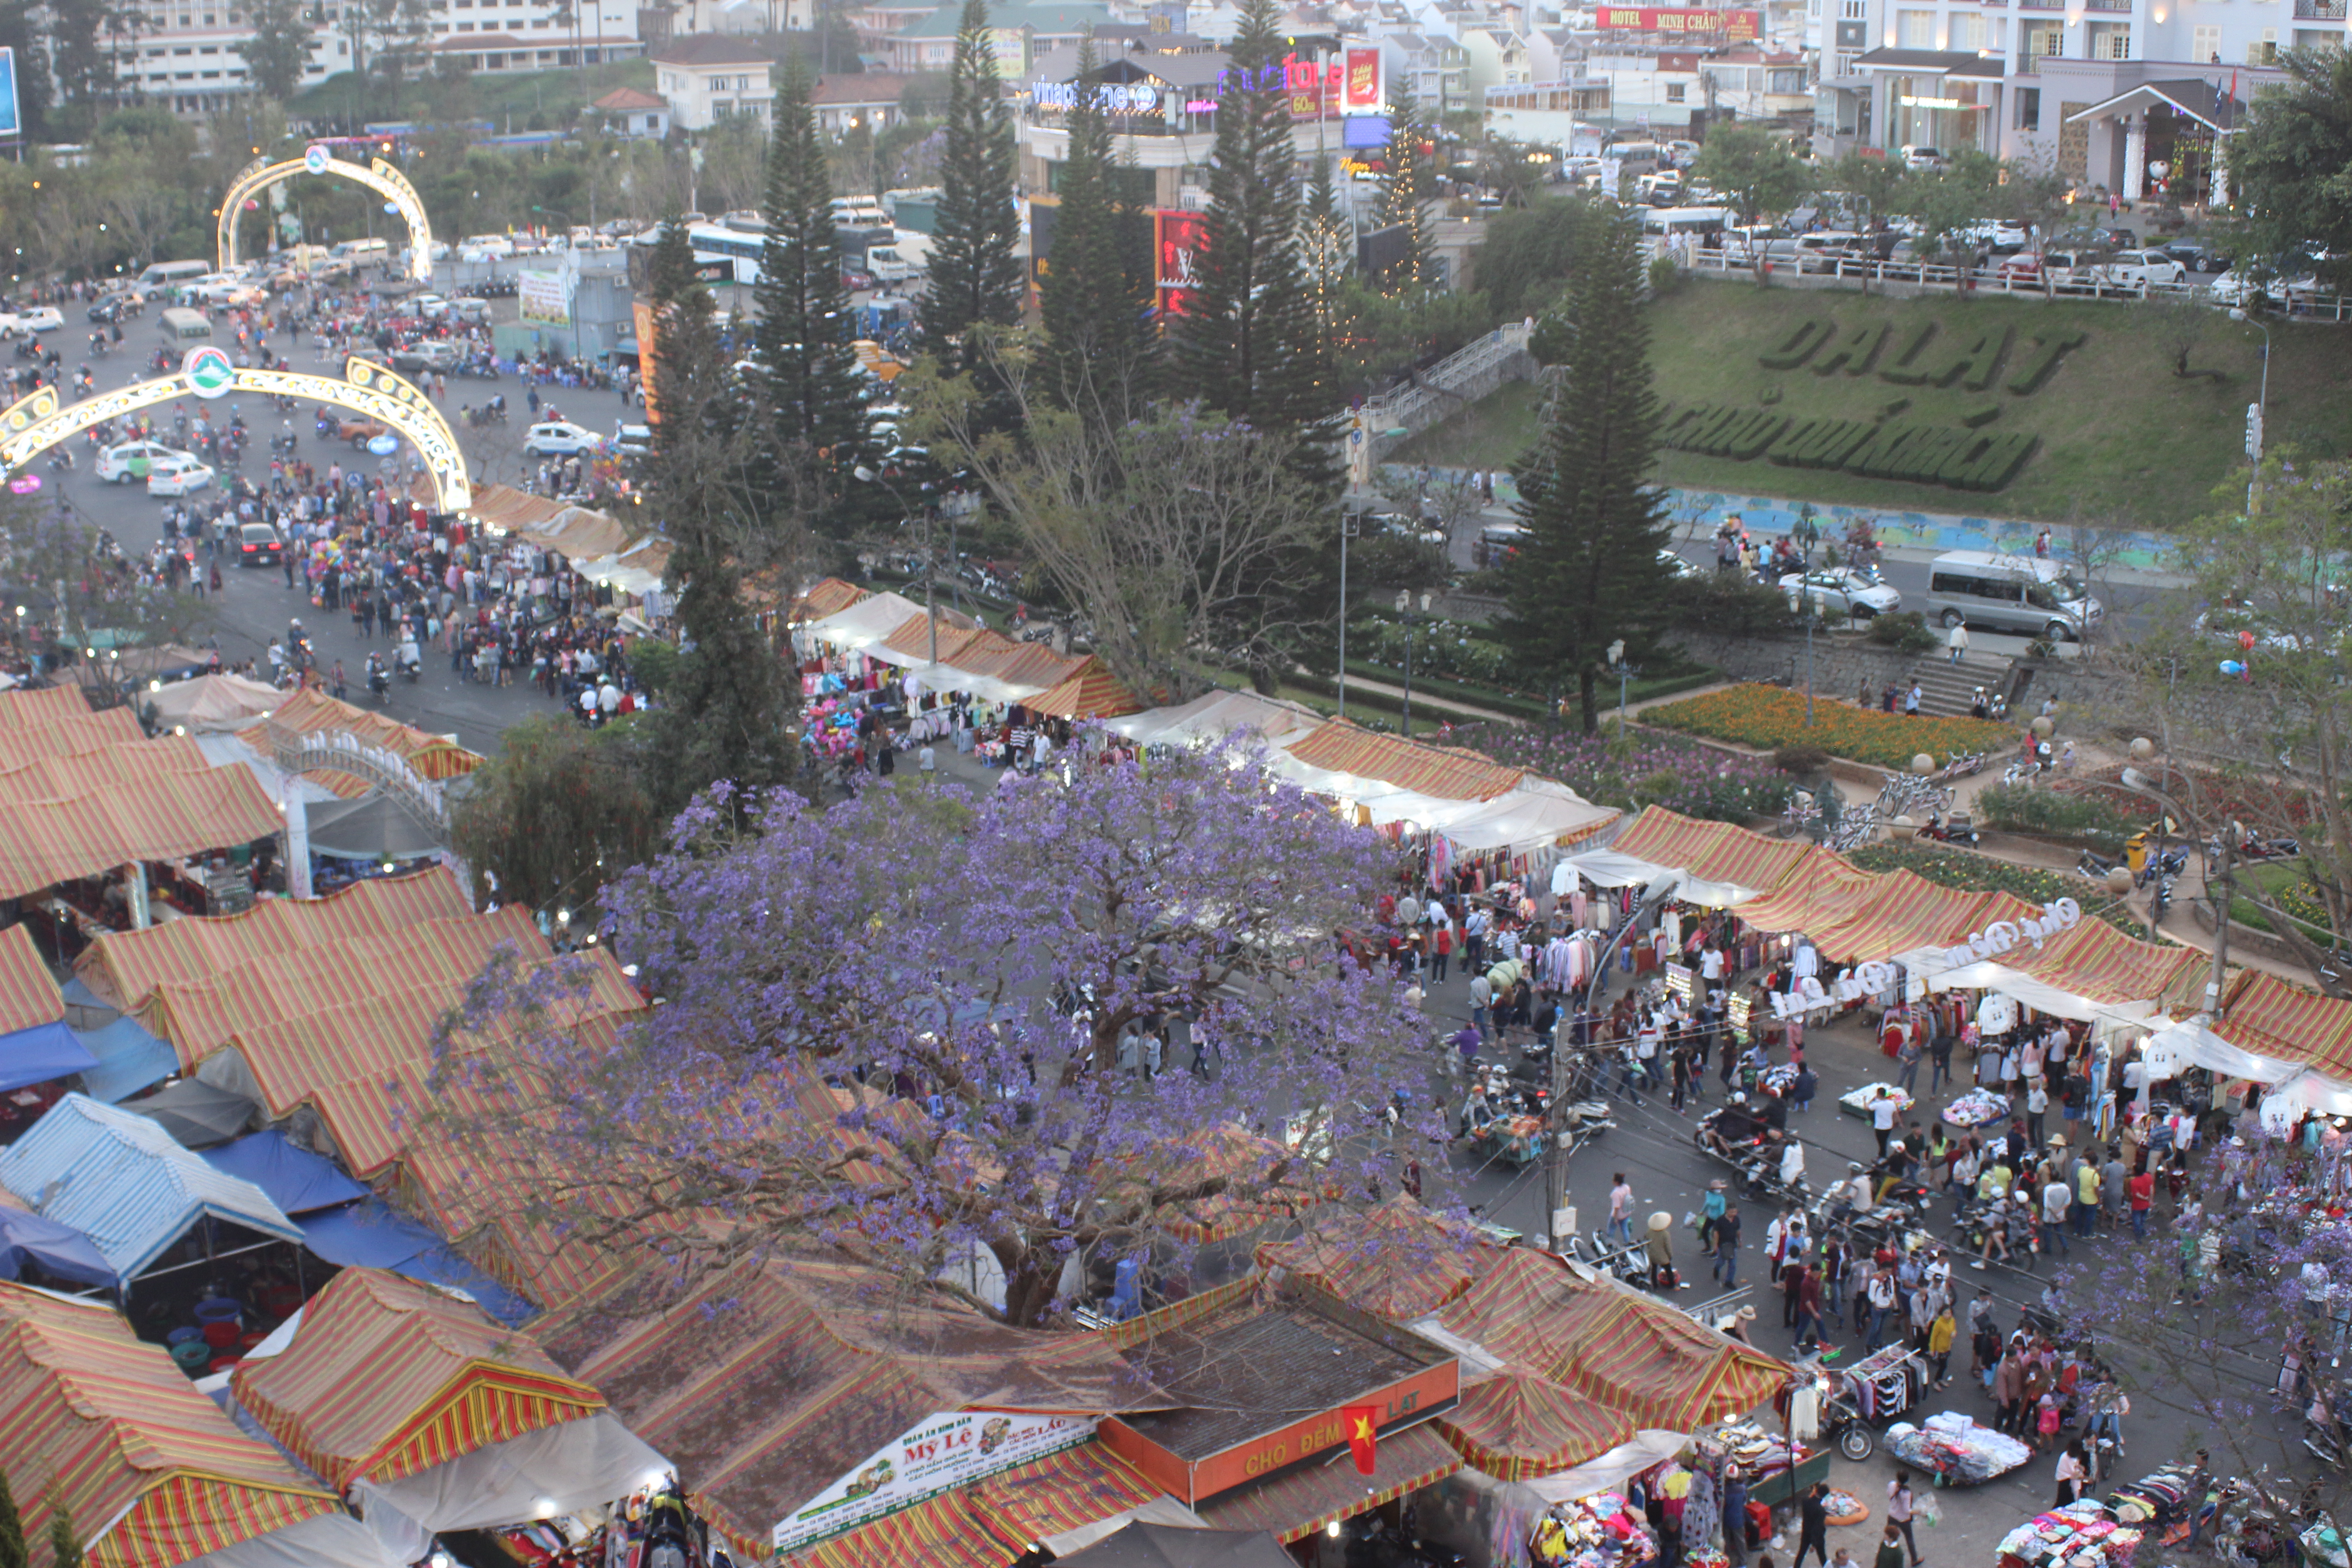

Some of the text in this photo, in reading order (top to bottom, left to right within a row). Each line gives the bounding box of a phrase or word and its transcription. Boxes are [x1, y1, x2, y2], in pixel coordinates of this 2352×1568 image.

[1611, 10, 1641, 26] HOTEL
[1657, 11, 1717, 30] MINH CHÂU
[1032, 74, 1128, 112] vinapne
[1339, 157, 1370, 177] Ngon
[903, 1433, 923, 1446] QUÁN
[926, 1429, 936, 1438] ĂN
[956, 1416, 972, 1427] DÂN
[903, 1428, 972, 1465] Mỹ Lệ
[1245, 1441, 1286, 1476] CHỢ
[1300, 1423, 1340, 1453] ĐÊM
[909, 1473, 924, 1482] CÁC
